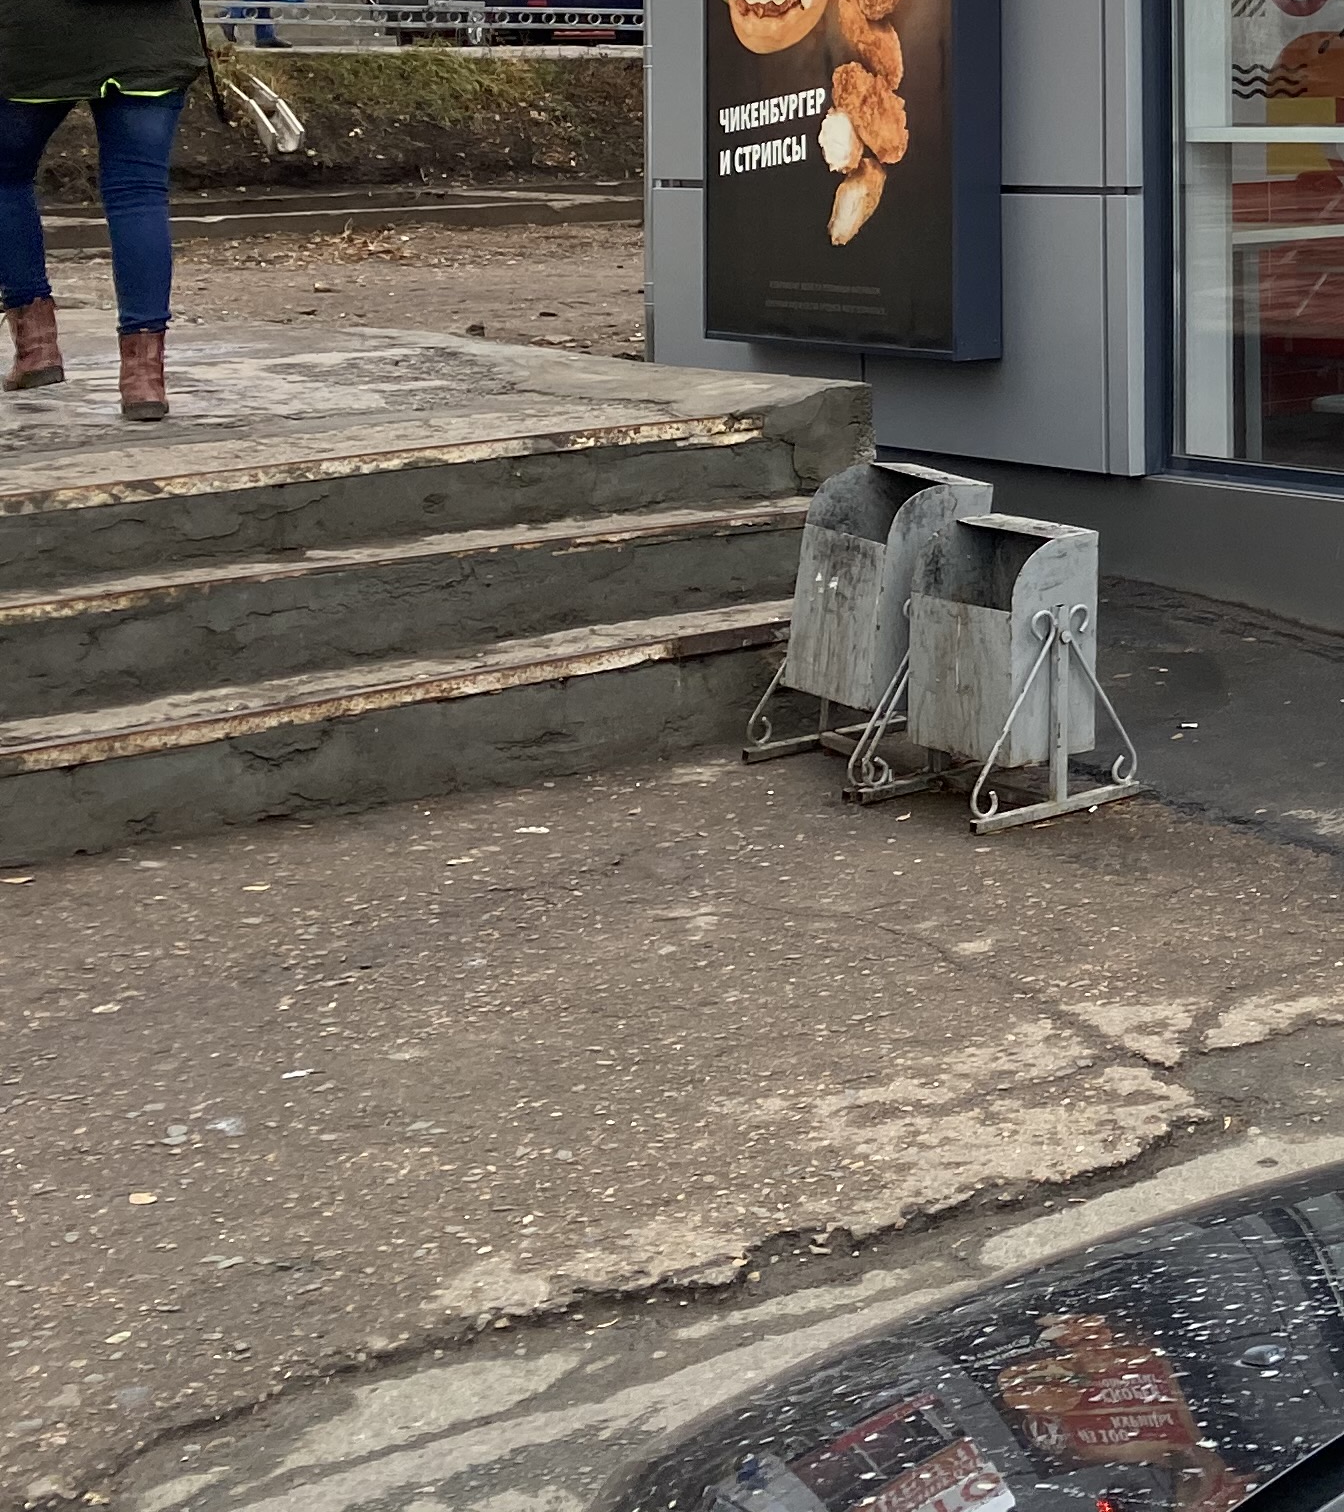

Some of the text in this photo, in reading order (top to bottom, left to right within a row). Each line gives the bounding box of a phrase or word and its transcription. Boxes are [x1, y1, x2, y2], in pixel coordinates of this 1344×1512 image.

[719, 87, 826, 134] ЧИКЕНБУРГЕР
[720, 134, 807, 176] И СТРИПСЫ
